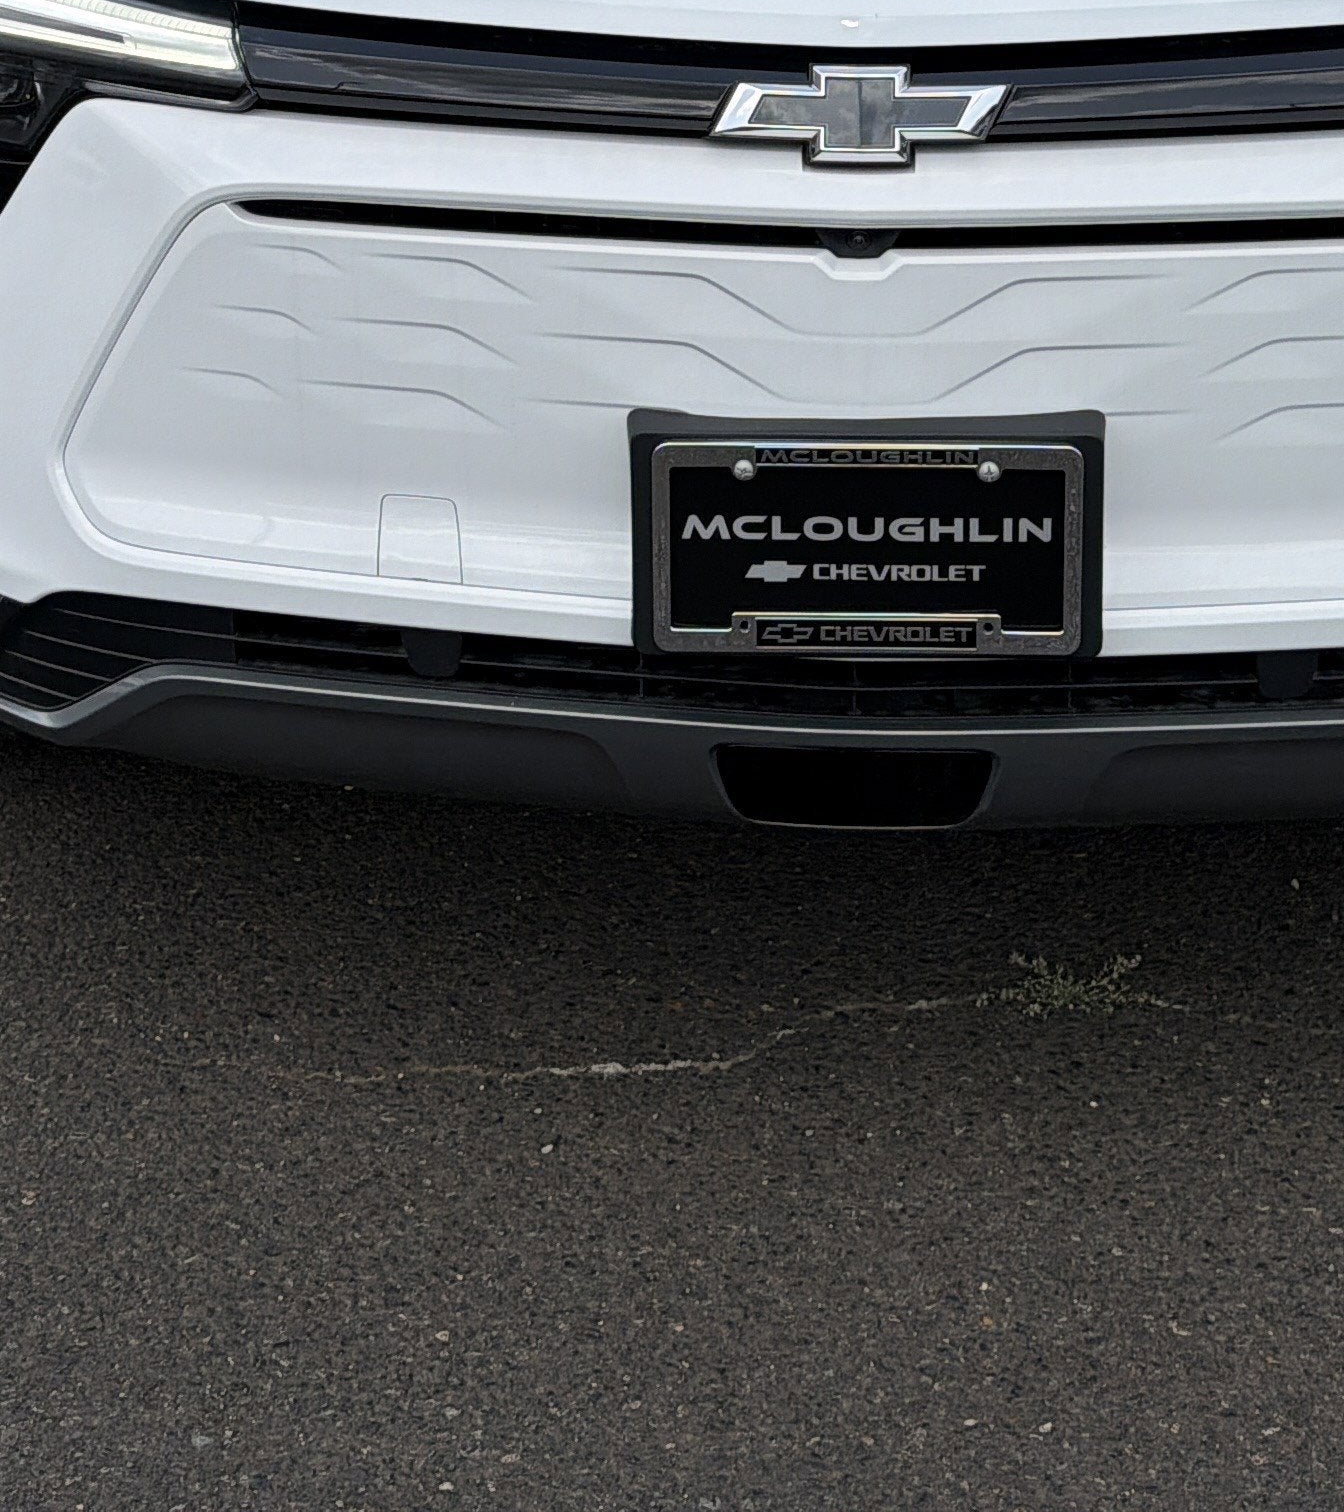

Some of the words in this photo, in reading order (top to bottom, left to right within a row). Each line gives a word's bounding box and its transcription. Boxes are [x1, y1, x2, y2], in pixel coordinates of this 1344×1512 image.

[760, 449, 974, 464] MCLOUGHLIN
[681, 514, 1053, 543] MCLOUGHLIN
[812, 563, 986, 582] CHEVROLET
[820, 625, 973, 644] CHEVROLET
